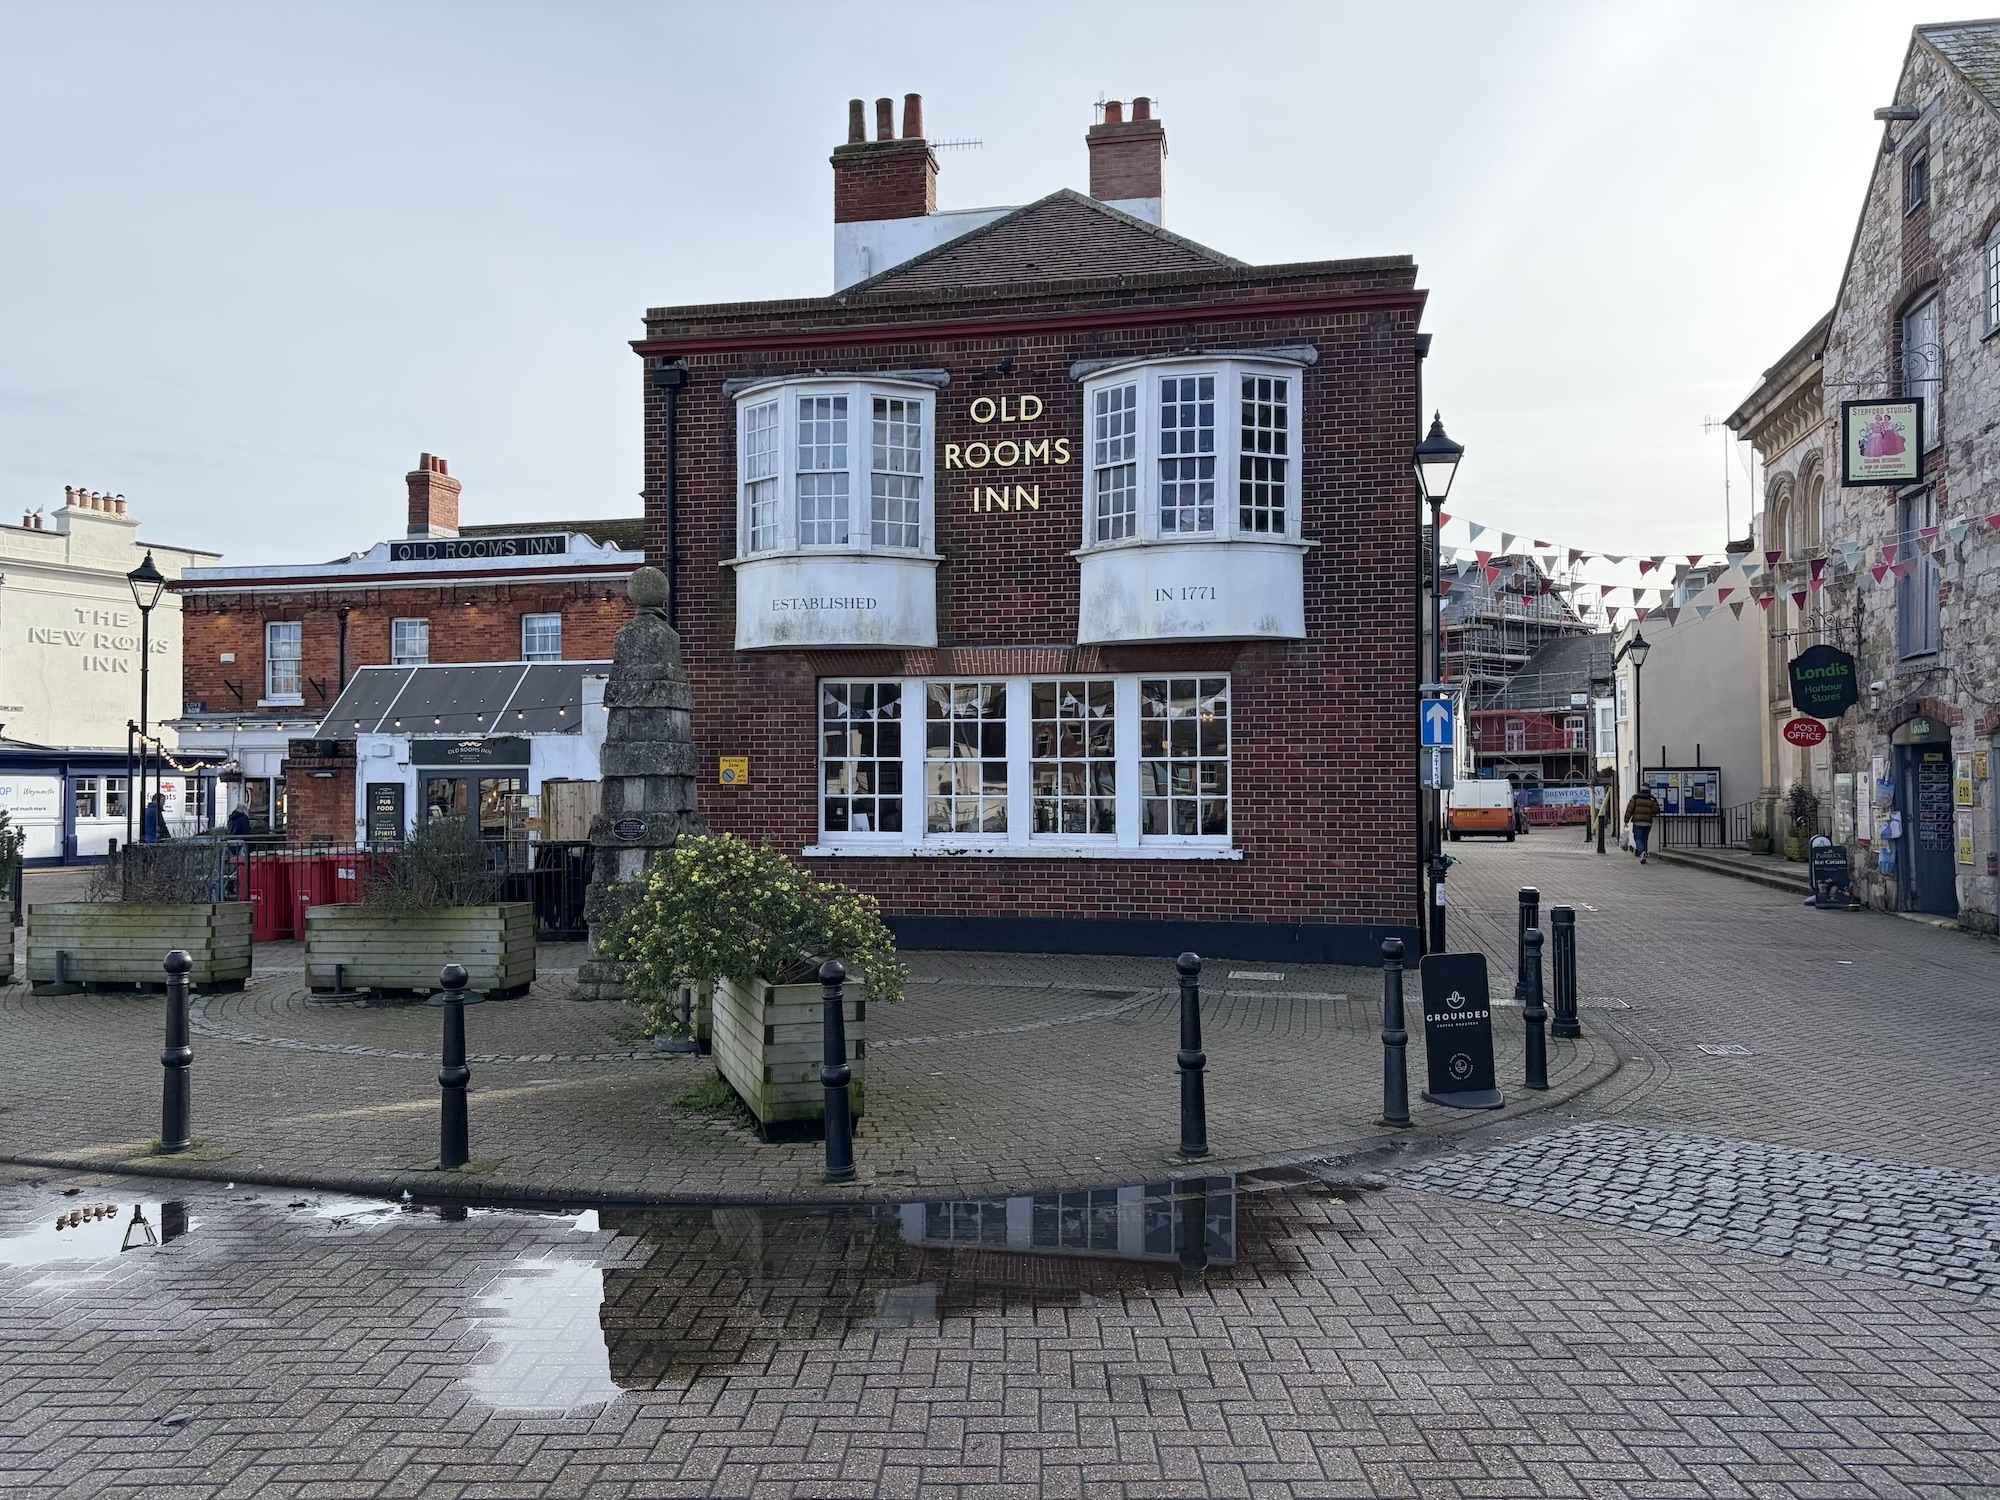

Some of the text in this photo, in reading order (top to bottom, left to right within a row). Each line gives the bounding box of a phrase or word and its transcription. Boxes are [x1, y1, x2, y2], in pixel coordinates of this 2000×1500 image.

[970, 395, 1043, 423] OLD
[1852, 405, 1912, 416] STEPFORD STUDIOS
[945, 438, 1071, 470] ROOMS
[973, 485, 1040, 512] INN
[398, 538, 557, 560] OLD ROOMS INN
[1155, 586, 1216, 602] IN 1771
[772, 597, 877, 611] ESTABLISHED
[74, 607, 131, 627] THE
[28, 627, 169, 654] NEW ROOMS
[83, 655, 130, 673] INN
[1795, 663, 1849, 680] Londis
[1804, 683, 1843, 694] Harbour
[1811, 693, 1841, 703] Stores
[1793, 723, 1818, 732] POST
[1787, 731, 1821, 741] OFFICE
[23, 787, 55, 797] Weymouth
[1545, 789, 1578, 798] BREWERS
[1960, 786, 1969, 797] £10
[1426, 1010, 1489, 1022] GROUNDED
